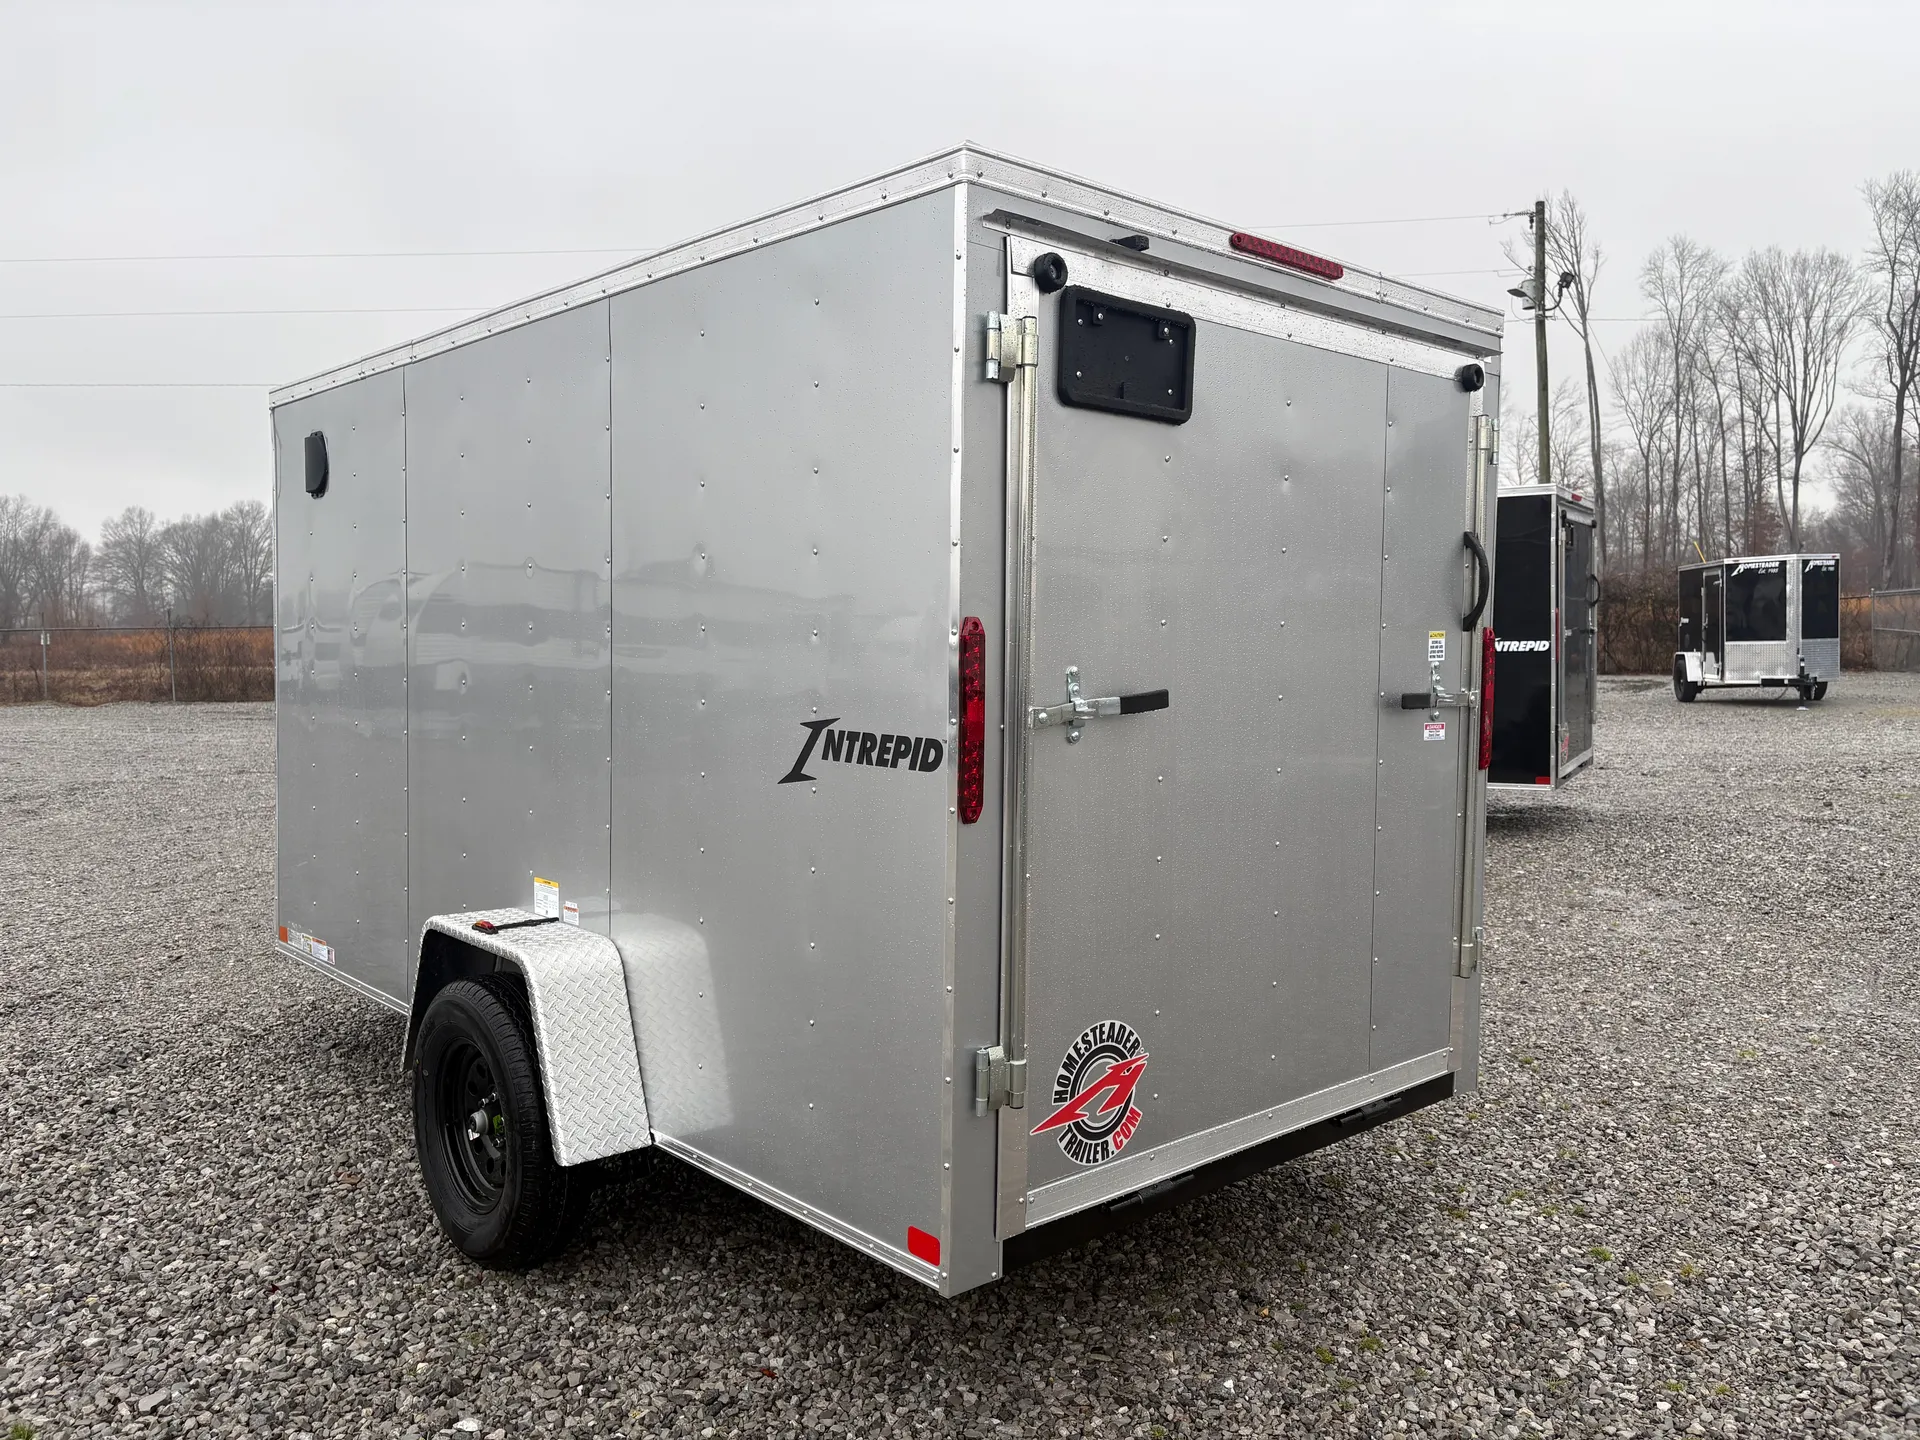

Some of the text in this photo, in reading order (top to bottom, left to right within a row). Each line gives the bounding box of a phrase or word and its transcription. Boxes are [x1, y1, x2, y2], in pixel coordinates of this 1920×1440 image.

[1495, 637, 1550, 652] NTREPID
[777, 717, 944, 785] INTREPID
[1053, 1022, 1141, 1104] HOMESTEADER
